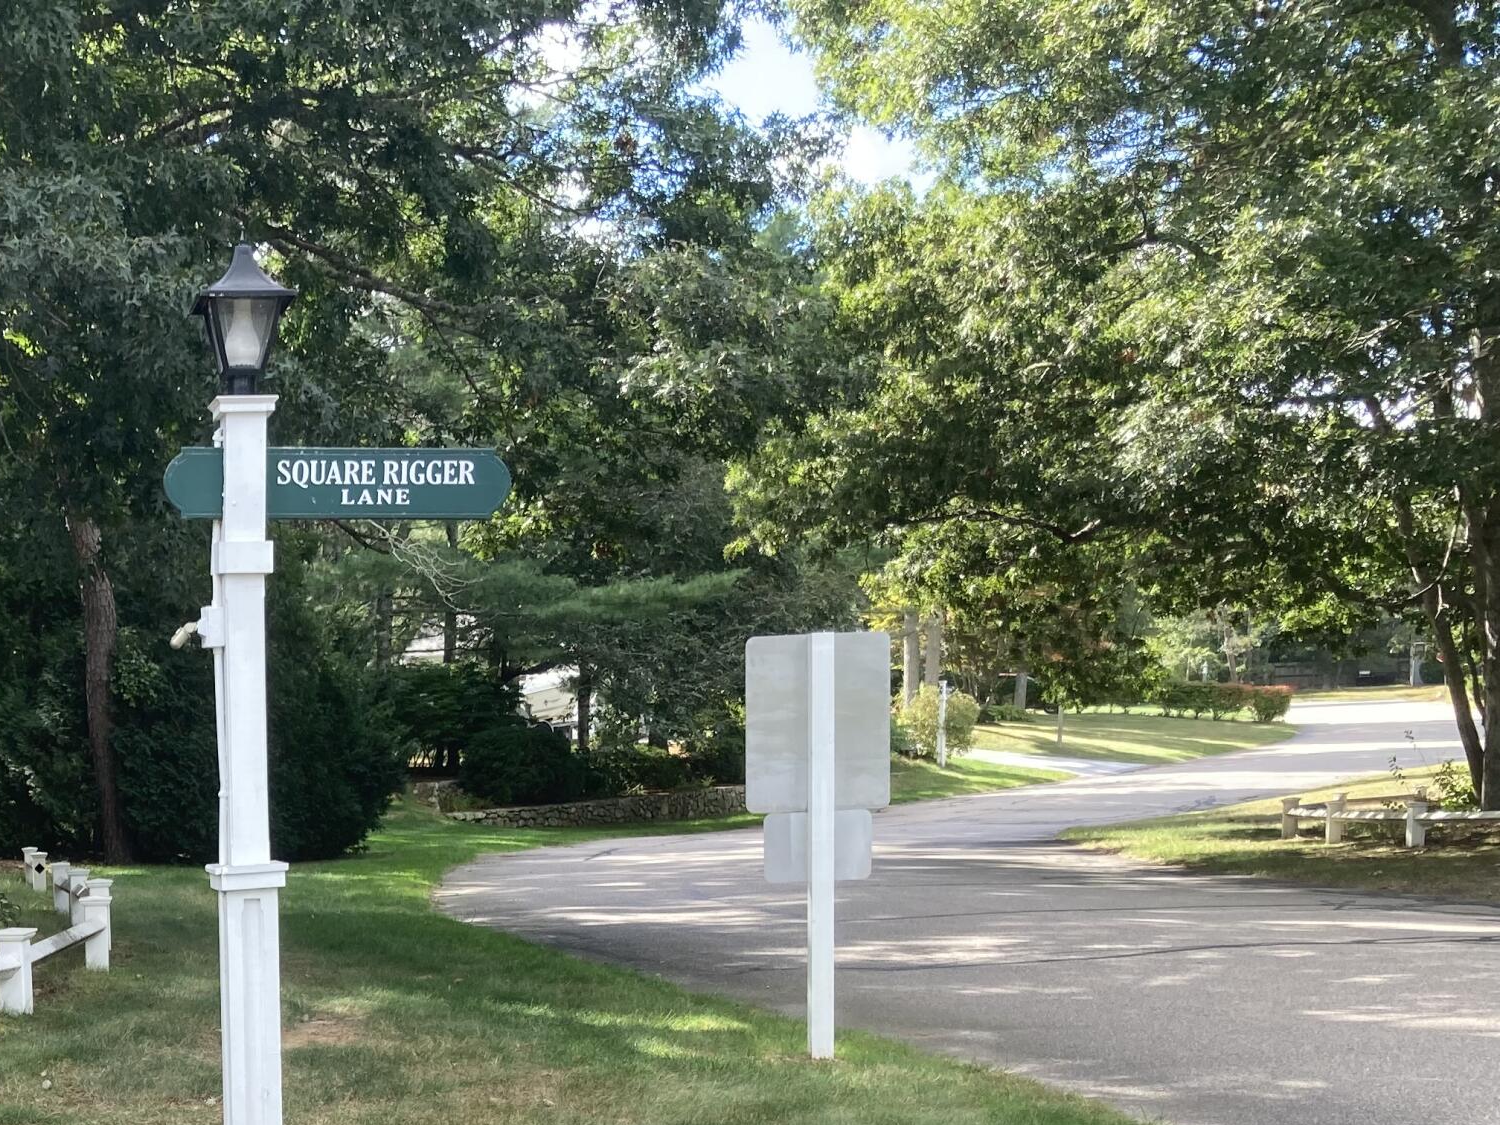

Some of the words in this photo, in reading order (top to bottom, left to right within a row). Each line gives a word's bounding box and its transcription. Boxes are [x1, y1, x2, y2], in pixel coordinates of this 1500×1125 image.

[277, 459, 376, 488] SQUARE
[382, 459, 476, 486] RIGGER
[340, 488, 410, 505] LANE
